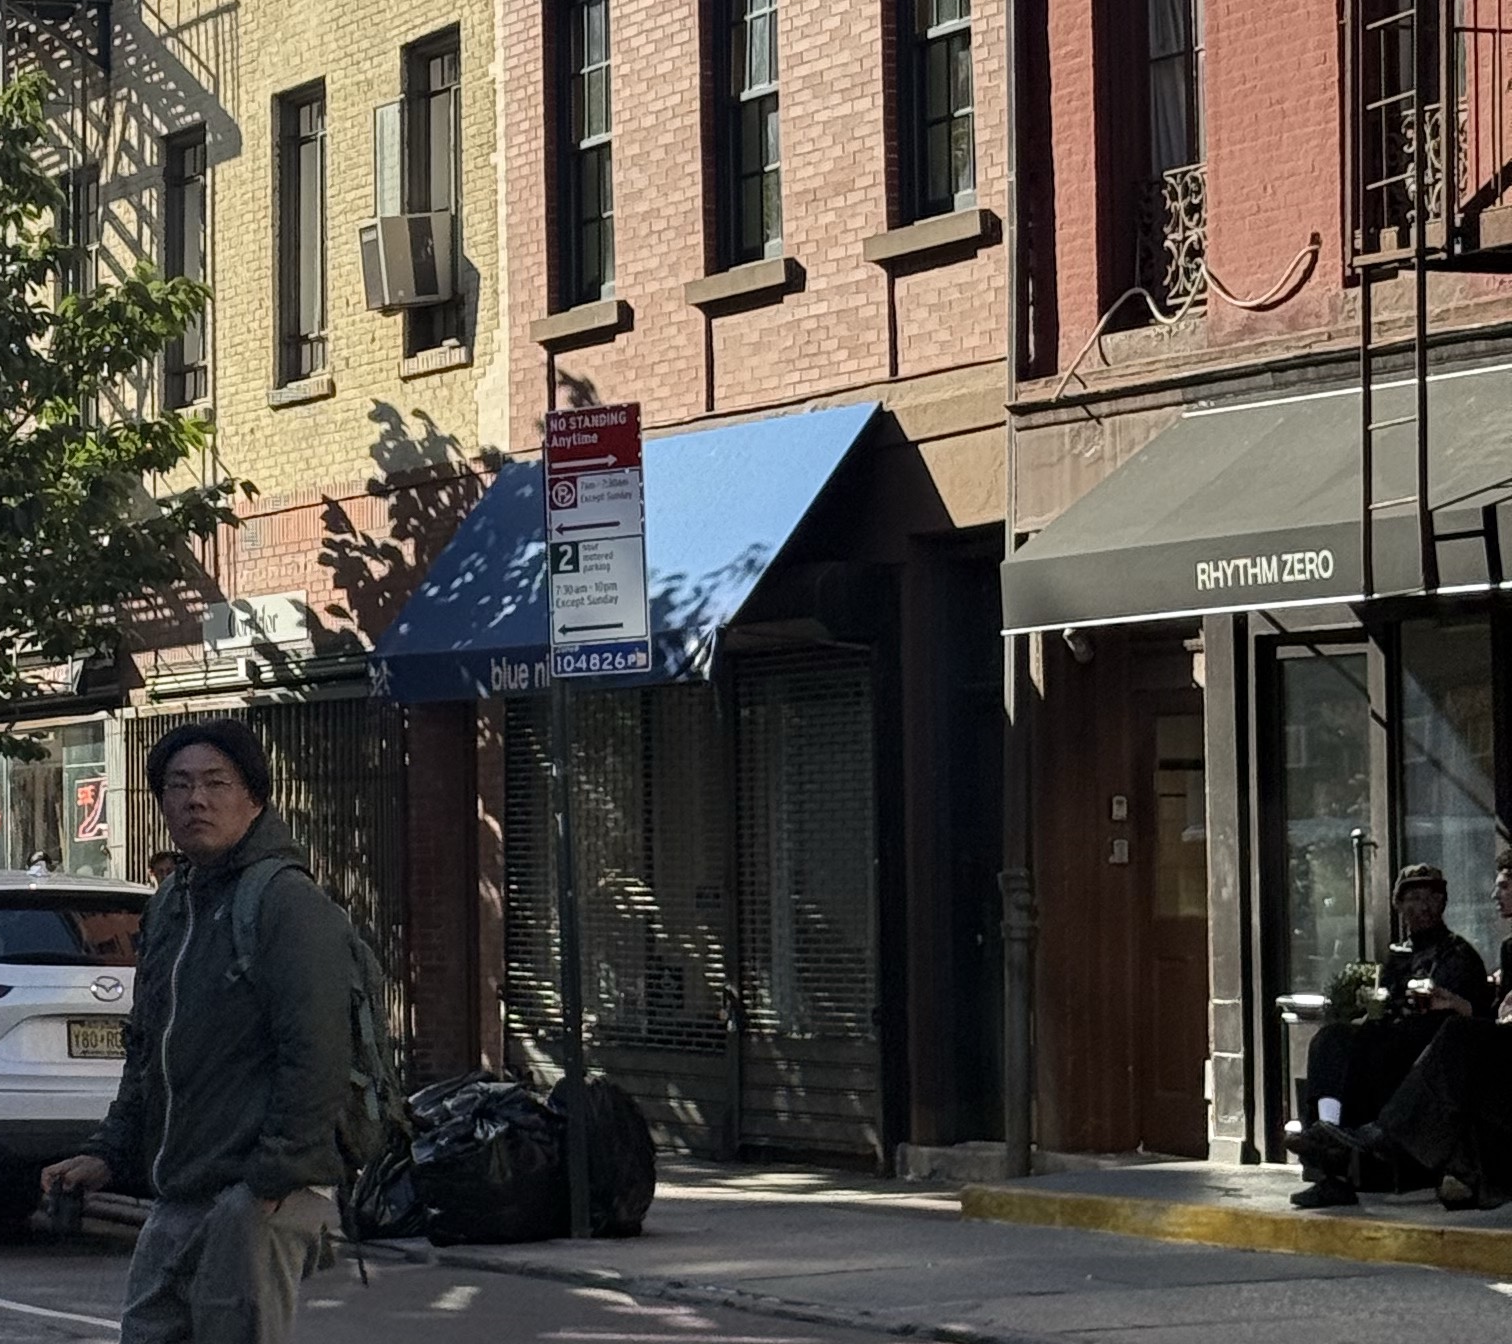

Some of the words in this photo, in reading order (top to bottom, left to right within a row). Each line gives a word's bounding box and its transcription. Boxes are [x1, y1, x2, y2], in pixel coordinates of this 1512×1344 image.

[550, 417, 567, 431] NO
[569, 411, 627, 430] STANDING
[551, 432, 598, 449] Anytime
[558, 544, 574, 572] 2
[583, 551, 614, 561] metered
[583, 563, 611, 573] parking
[1196, 555, 1279, 591] RHYTHM
[1281, 549, 1334, 582] ZERO
[556, 597, 585, 609] Except
[587, 594, 619, 606] Sunday
[556, 651, 626, 673] 104826
[490, 656, 530, 691] blue
